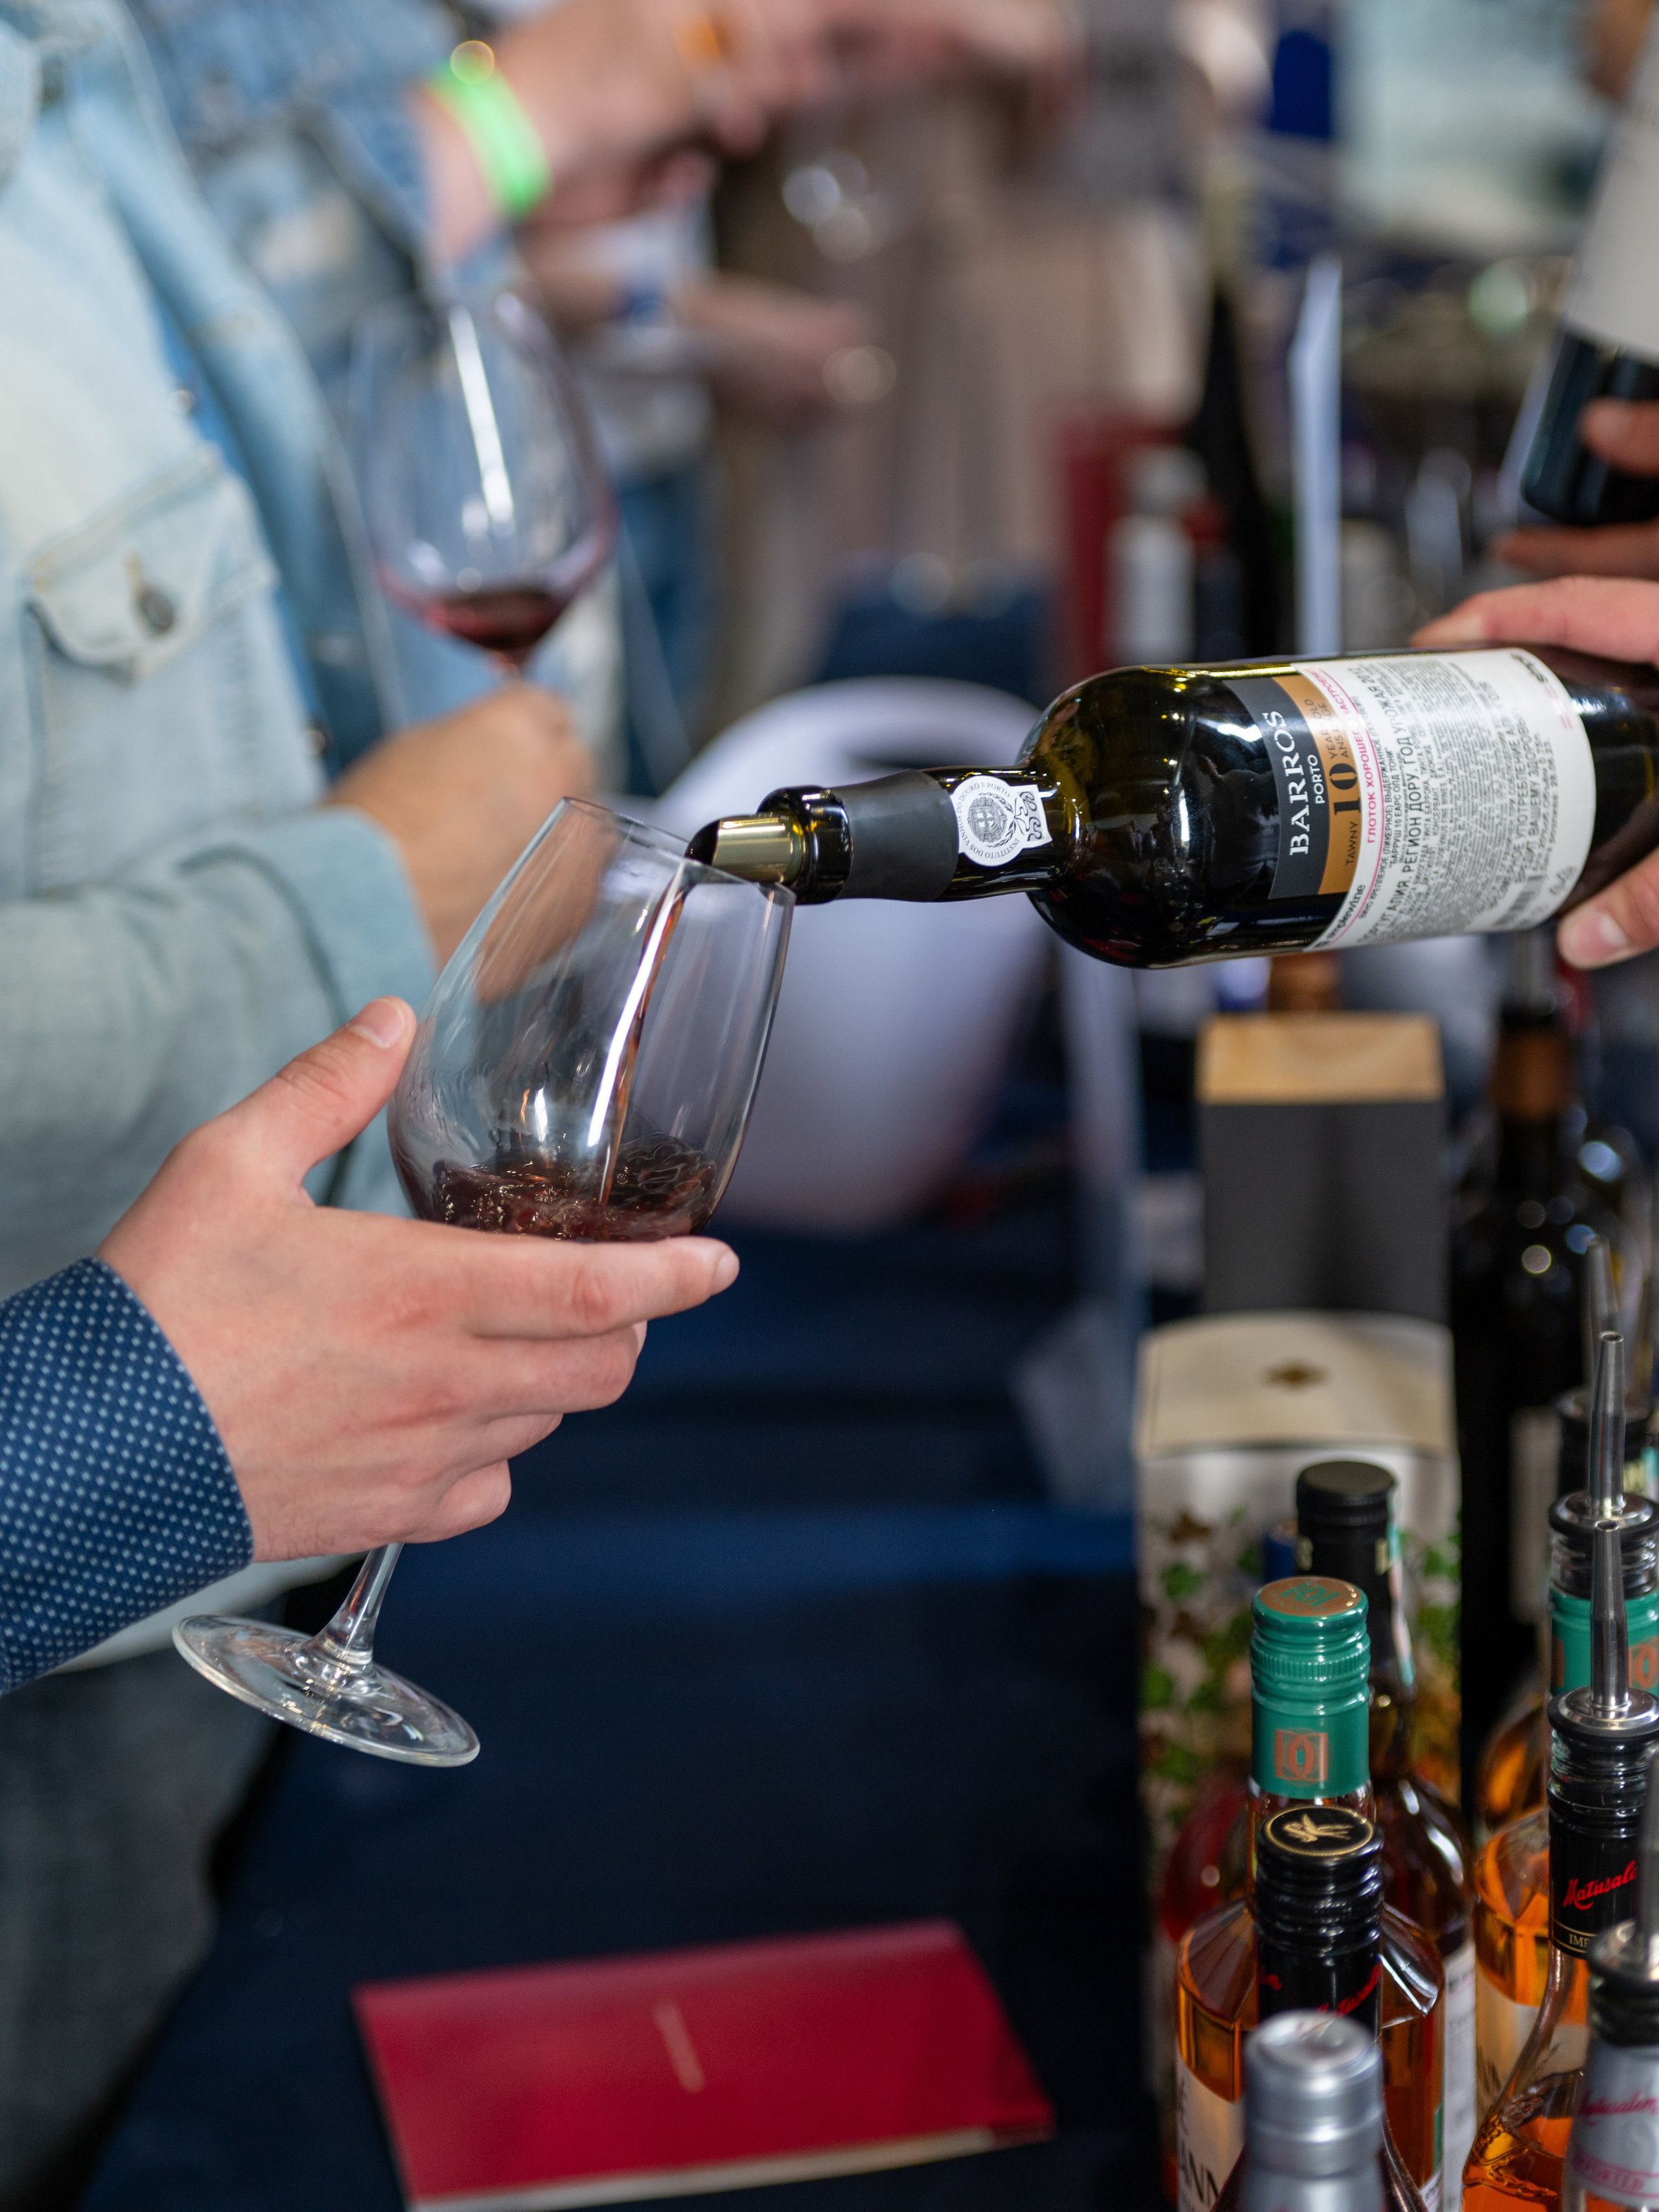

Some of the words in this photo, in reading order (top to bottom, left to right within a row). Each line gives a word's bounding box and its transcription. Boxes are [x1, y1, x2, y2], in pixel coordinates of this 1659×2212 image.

[1304, 699, 1321, 719] OLD
[1316, 721, 1338, 759] YEAR
[1333, 733, 1349, 758] ANS
[1348, 723, 1374, 787] ХОРОШЕГ
[1396, 736, 1415, 763] ГОД
[1261, 710, 1310, 856] BARROS
[1306, 754, 1325, 804] PORTO
[1371, 738, 1393, 802] ВЫДЕРЖАННОЕ
[1391, 774, 1400, 792] ОЛД
[958, 782, 980, 802] DOURO
[987, 782, 1010, 798] PORTO
[1326, 762, 1362, 815] 10
[1393, 793, 1402, 817] ЕАРС
[1405, 769, 1422, 811] ДОРУ.
[1508, 739, 1528, 839] УПОТРЕБЛЕНИЕ
[956, 802, 962, 813] DO
[1367, 791, 1376, 843] ГЛОТОК
[1395, 819, 1402, 828] 10
[957, 815, 970, 845] VINHOS
[1345, 820, 1357, 865] TAWNY
[1382, 804, 1393, 855] (ЛИКЕРНОЕ)
[1401, 816, 1421, 872] РЕГИОН
[969, 844, 983, 857] DOS
[985, 837, 1020, 859] INSTITUTO
